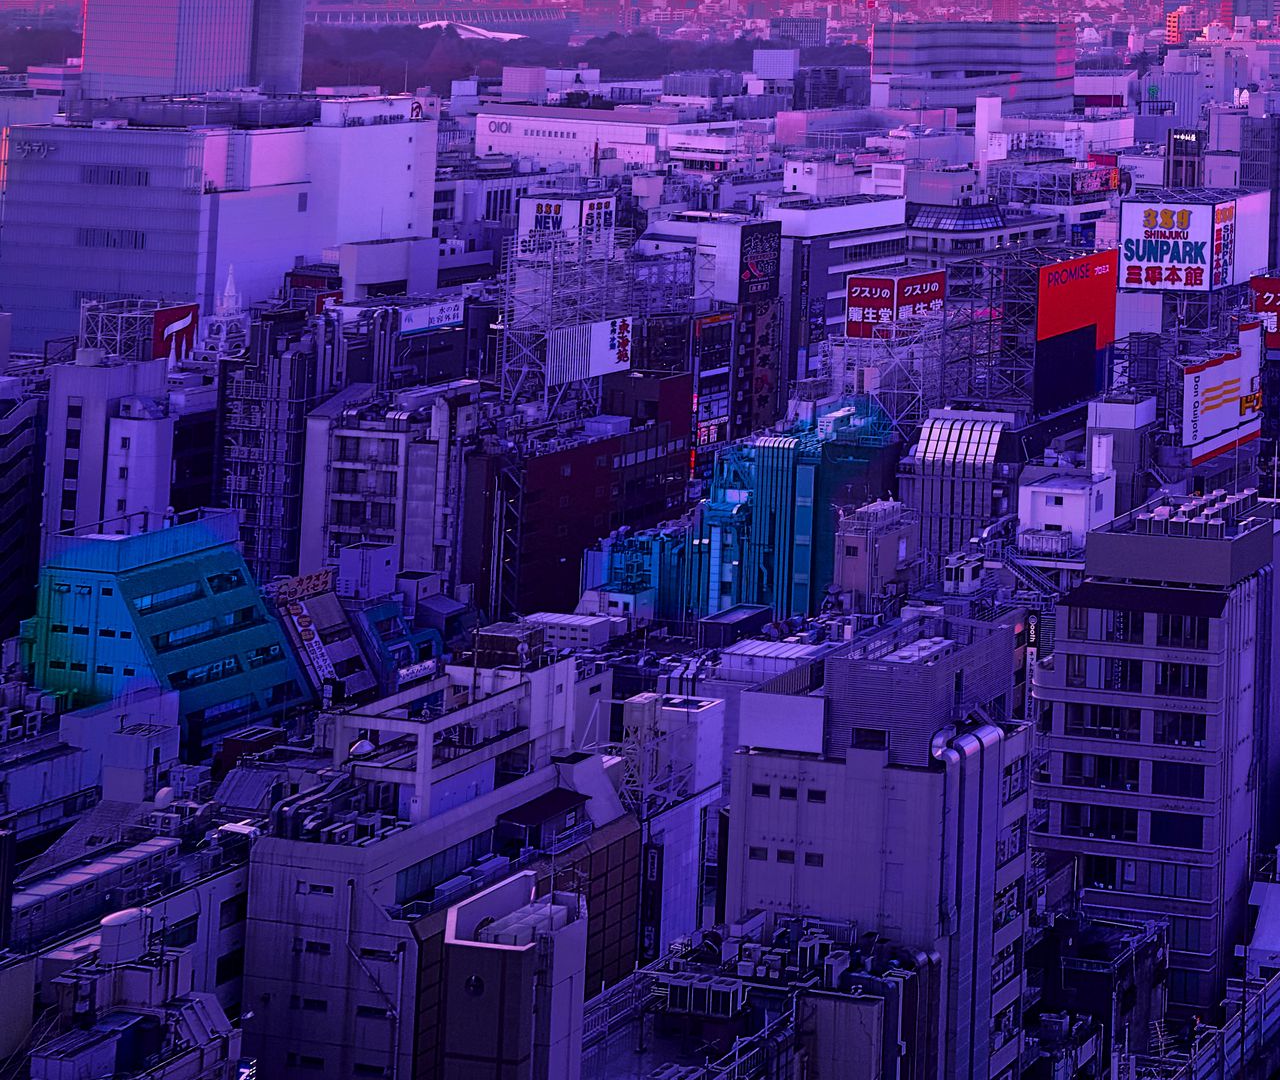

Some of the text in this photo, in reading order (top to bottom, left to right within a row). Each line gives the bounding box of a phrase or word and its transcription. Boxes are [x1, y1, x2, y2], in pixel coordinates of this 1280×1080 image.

[535, 215, 562, 230] NEW
[1143, 208, 1193, 230] 389
[1144, 230, 1189, 240] SHINJUKU
[1124, 238, 1207, 264] SUNPARK
[1220, 224, 1229, 285] SUNPARK
[1047, 263, 1091, 288] PROMISE
[1125, 265, 1205, 287] 三平本館
[851, 287, 891, 298] クスリの
[904, 282, 940, 297] クスリの
[1190, 400, 1200, 441] Quijote
